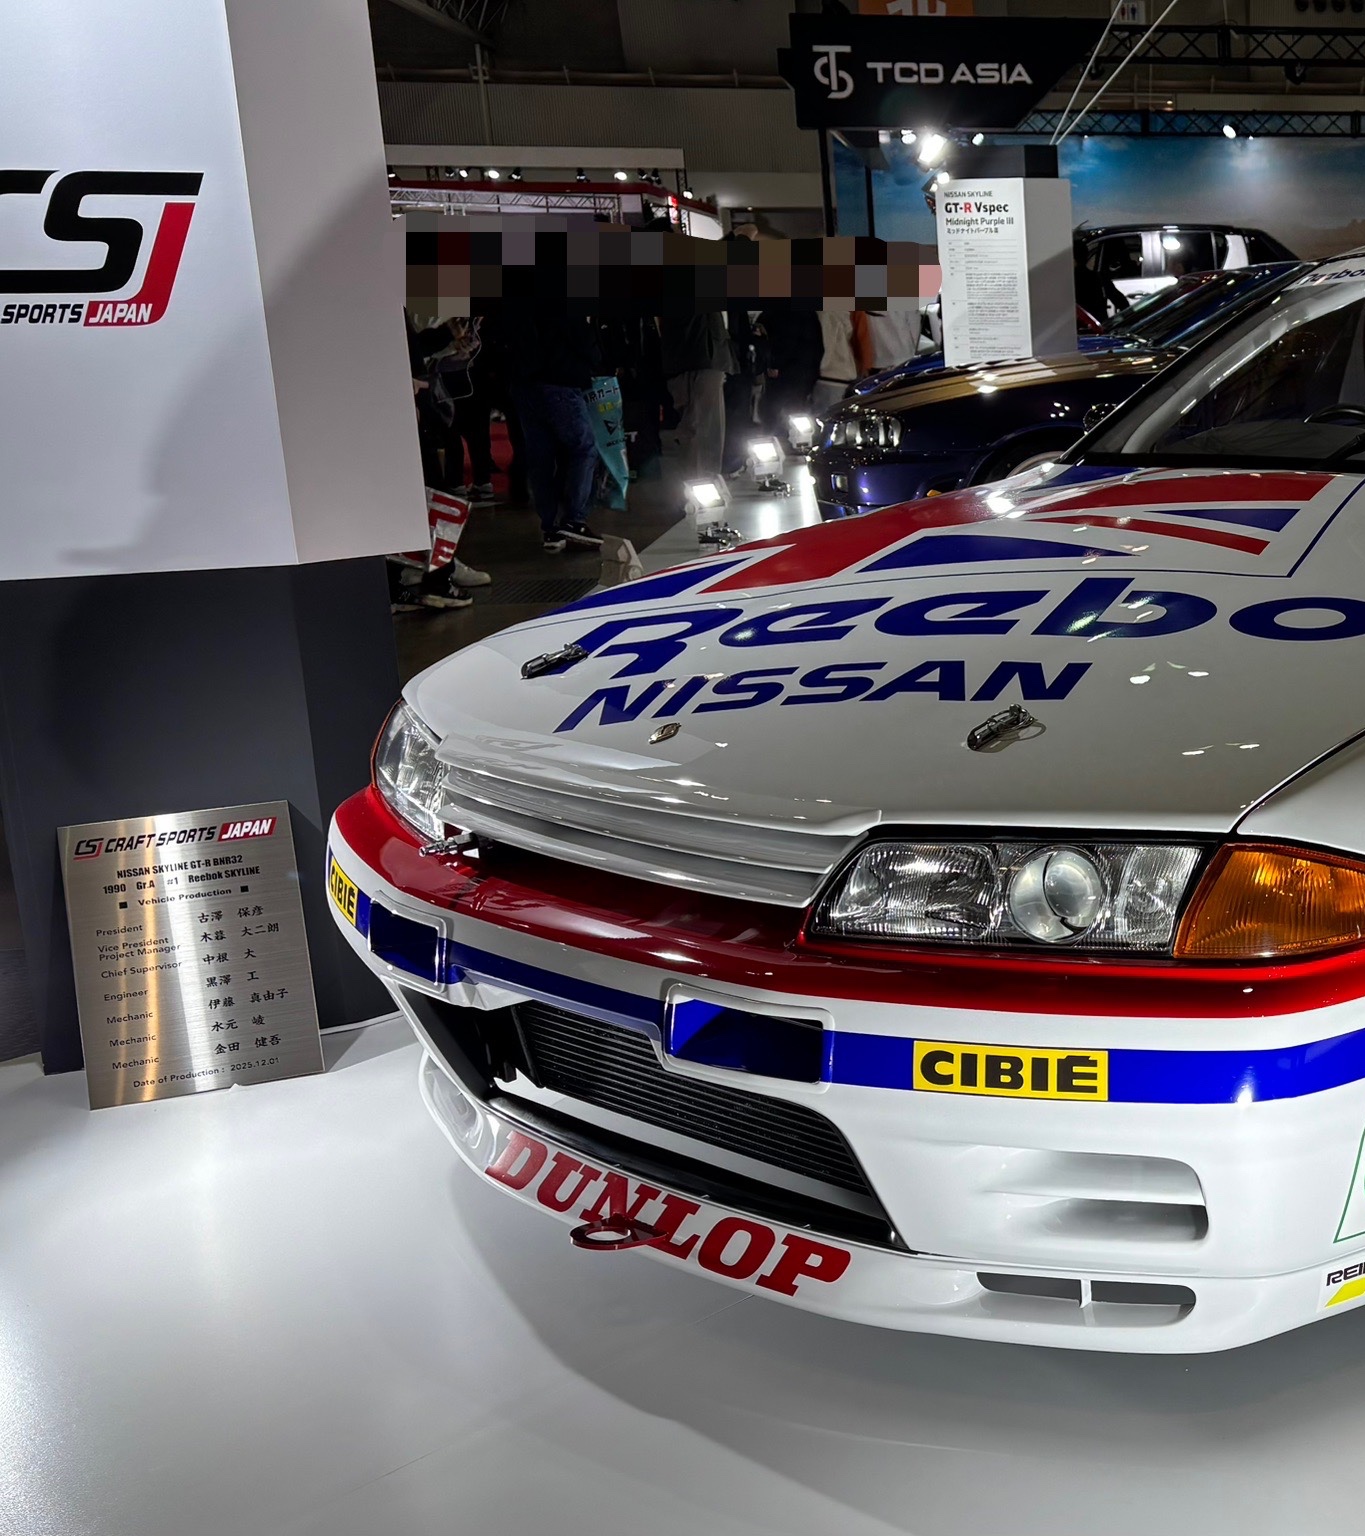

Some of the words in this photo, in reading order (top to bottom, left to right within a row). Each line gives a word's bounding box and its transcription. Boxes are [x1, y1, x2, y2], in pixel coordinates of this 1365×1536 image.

[866, 62, 944, 84] TCD
[951, 63, 1033, 85] ASIA
[968, 190, 993, 198] SKYLINE
[944, 202, 972, 214] GT-R
[974, 202, 1009, 215] Vspec
[945, 217, 979, 226] Midnight
[980, 217, 1005, 227] Purple
[1, 304, 84, 324] SPORTS
[88, 303, 153, 324] JAPAN
[554, 660, 1094, 733] NISSAN
[105, 834, 156, 853] CRAFT
[156, 826, 217, 847] SPORTS
[222, 819, 273, 840] JAPAN
[116, 869, 151, 879] NISSAN
[152, 862, 189, 875] SKYLINE
[190, 859, 212, 869] GT-R
[213, 854, 244, 866] BNR32
[102, 883, 127, 895] 1990
[136, 879, 156, 891] Gr.A
[188, 871, 224, 884] Reebok
[224, 866, 261, 879] SKYLINE
[178, 887, 232, 901] Production
[96, 924, 143, 937] President
[97, 944, 122, 954] Vice
[124, 935, 169, 949] President
[99, 951, 134, 963] Project
[137, 944, 181, 959] Manager
[101, 967, 128, 979] Chief
[130, 960, 182, 976] Supervisor
[104, 988, 149, 1002] Engineer
[106, 1011, 154, 1025] Mechanic
[109, 1034, 157, 1048] Mechanic
[112, 1056, 160, 1070] Mechanic
[133, 1080, 155, 1088] Date
[158, 1077, 168, 1085] of
[230, 1056, 280, 1072] 2025.12.01
[920, 1049, 1098, 1093] CIBIÉ
[486, 1130, 852, 1297] DUNLOP
